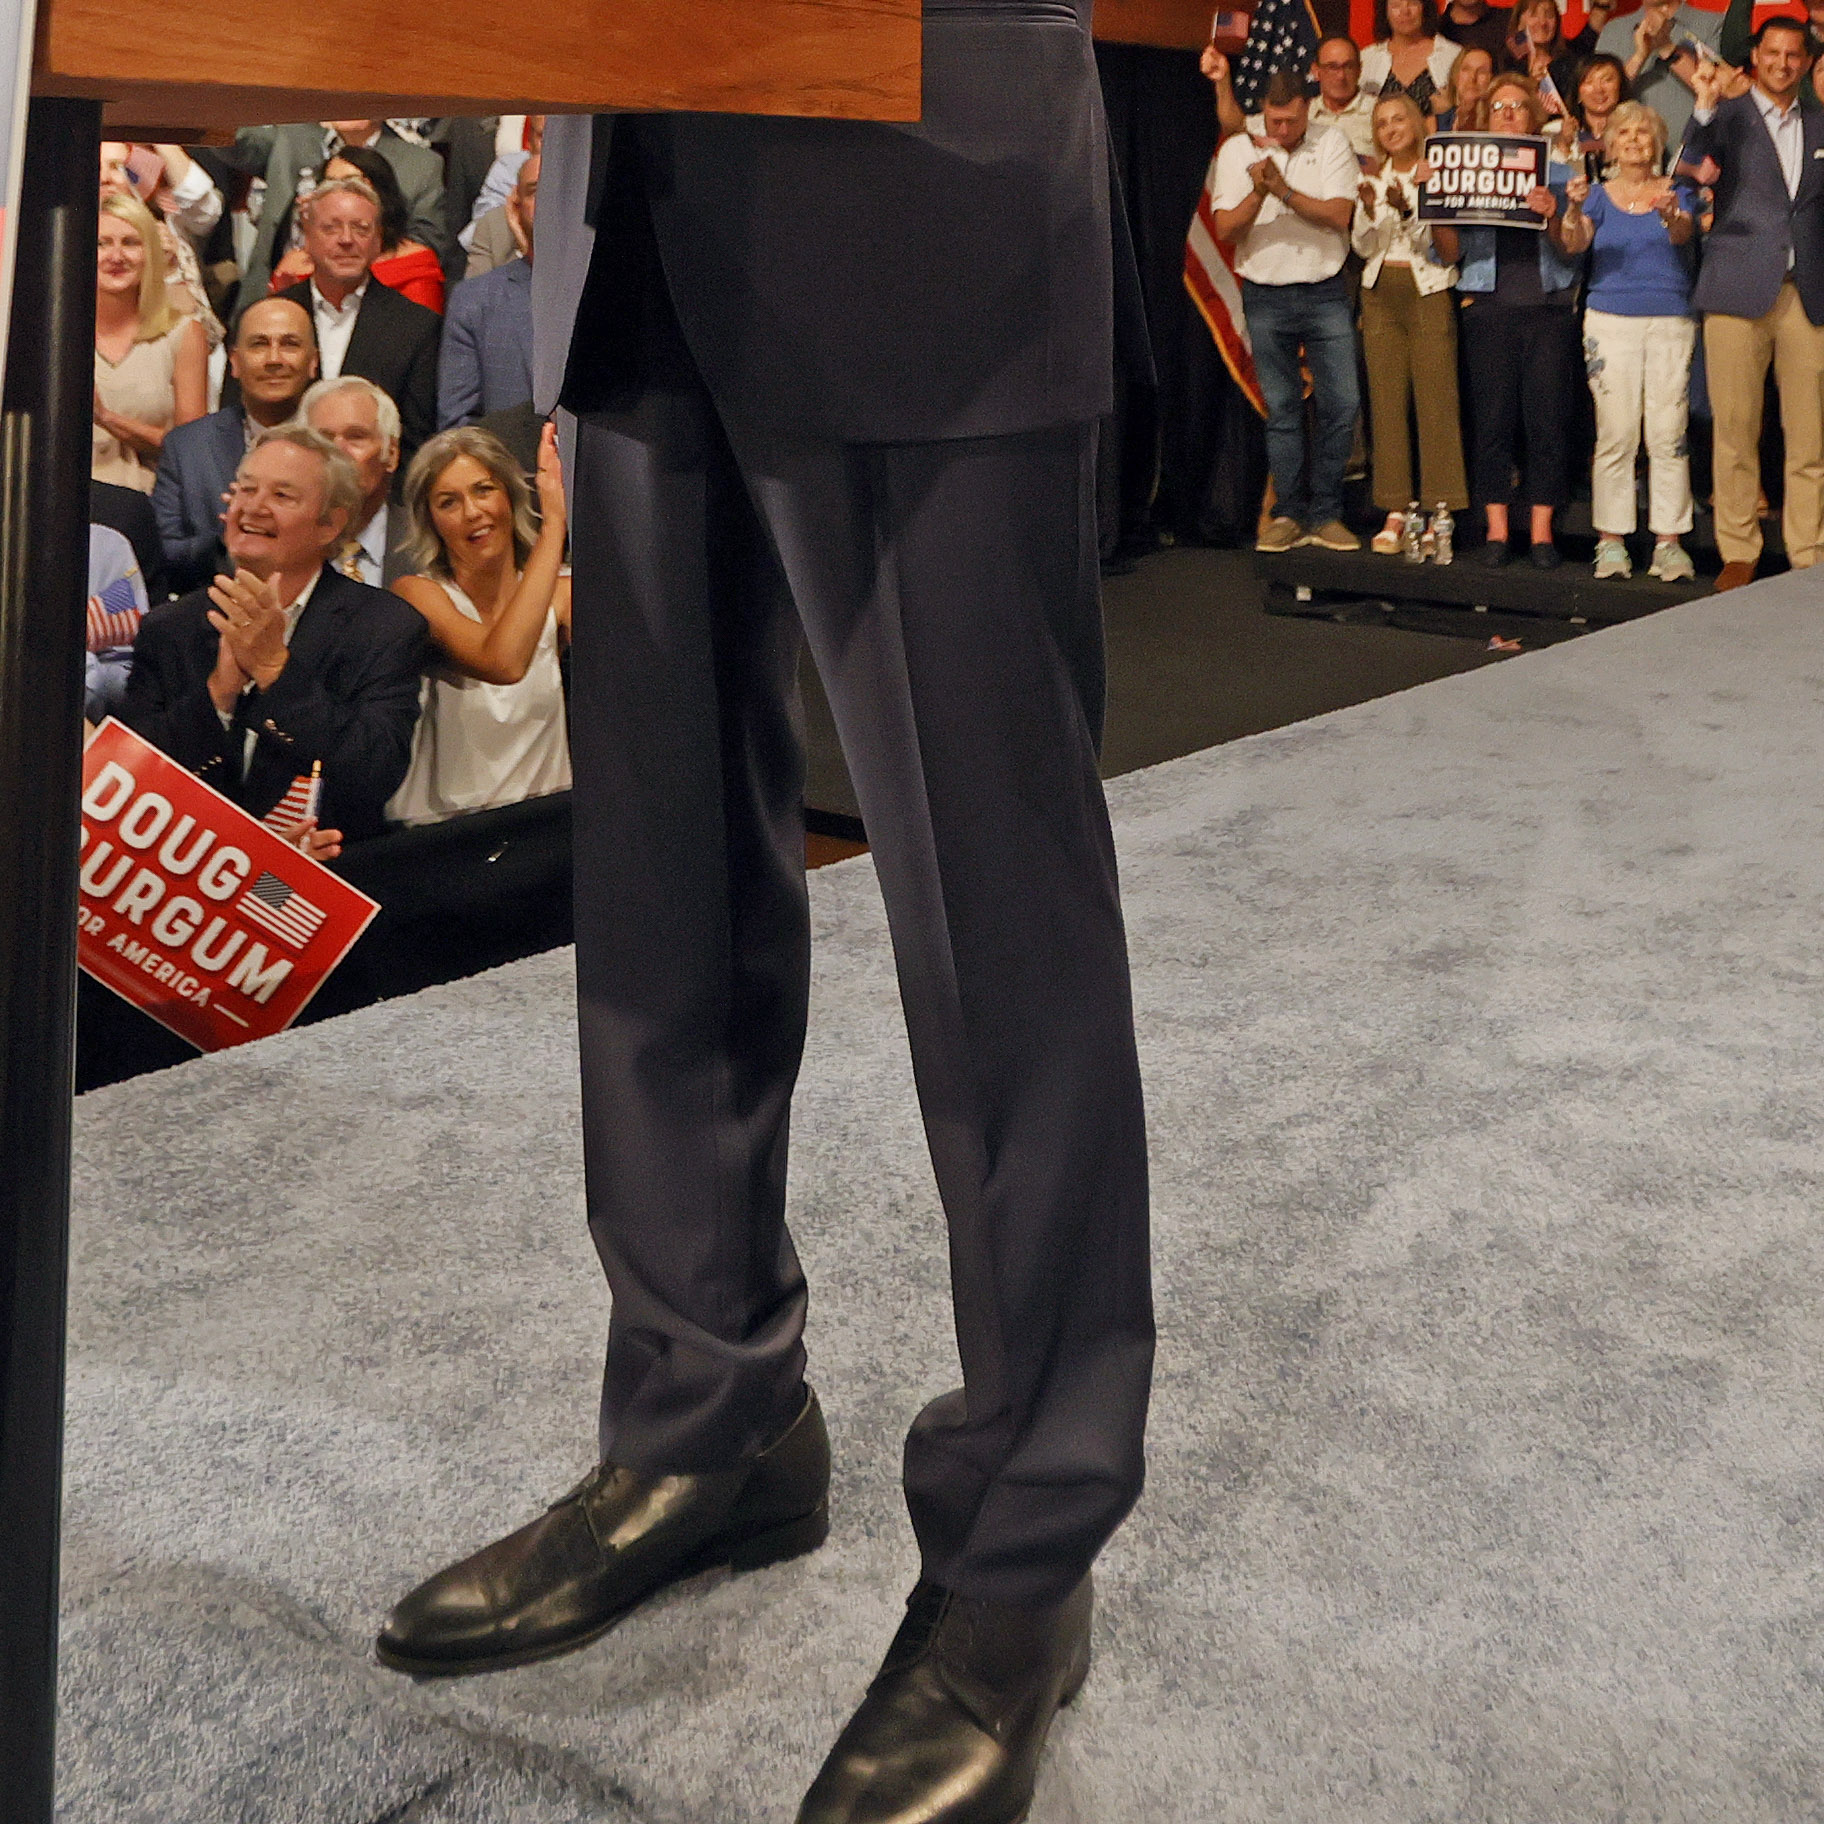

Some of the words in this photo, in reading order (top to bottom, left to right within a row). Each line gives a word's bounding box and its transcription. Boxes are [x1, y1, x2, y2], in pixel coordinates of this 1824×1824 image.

[1426, 168, 1537, 196] BURGUM
[1428, 143, 1501, 169] DOUG
[81, 760, 252, 902] DOUG
[78, 905, 107, 937] OR
[106, 932, 214, 1008] AMERICA
[79, 824, 295, 1004] URGUM
